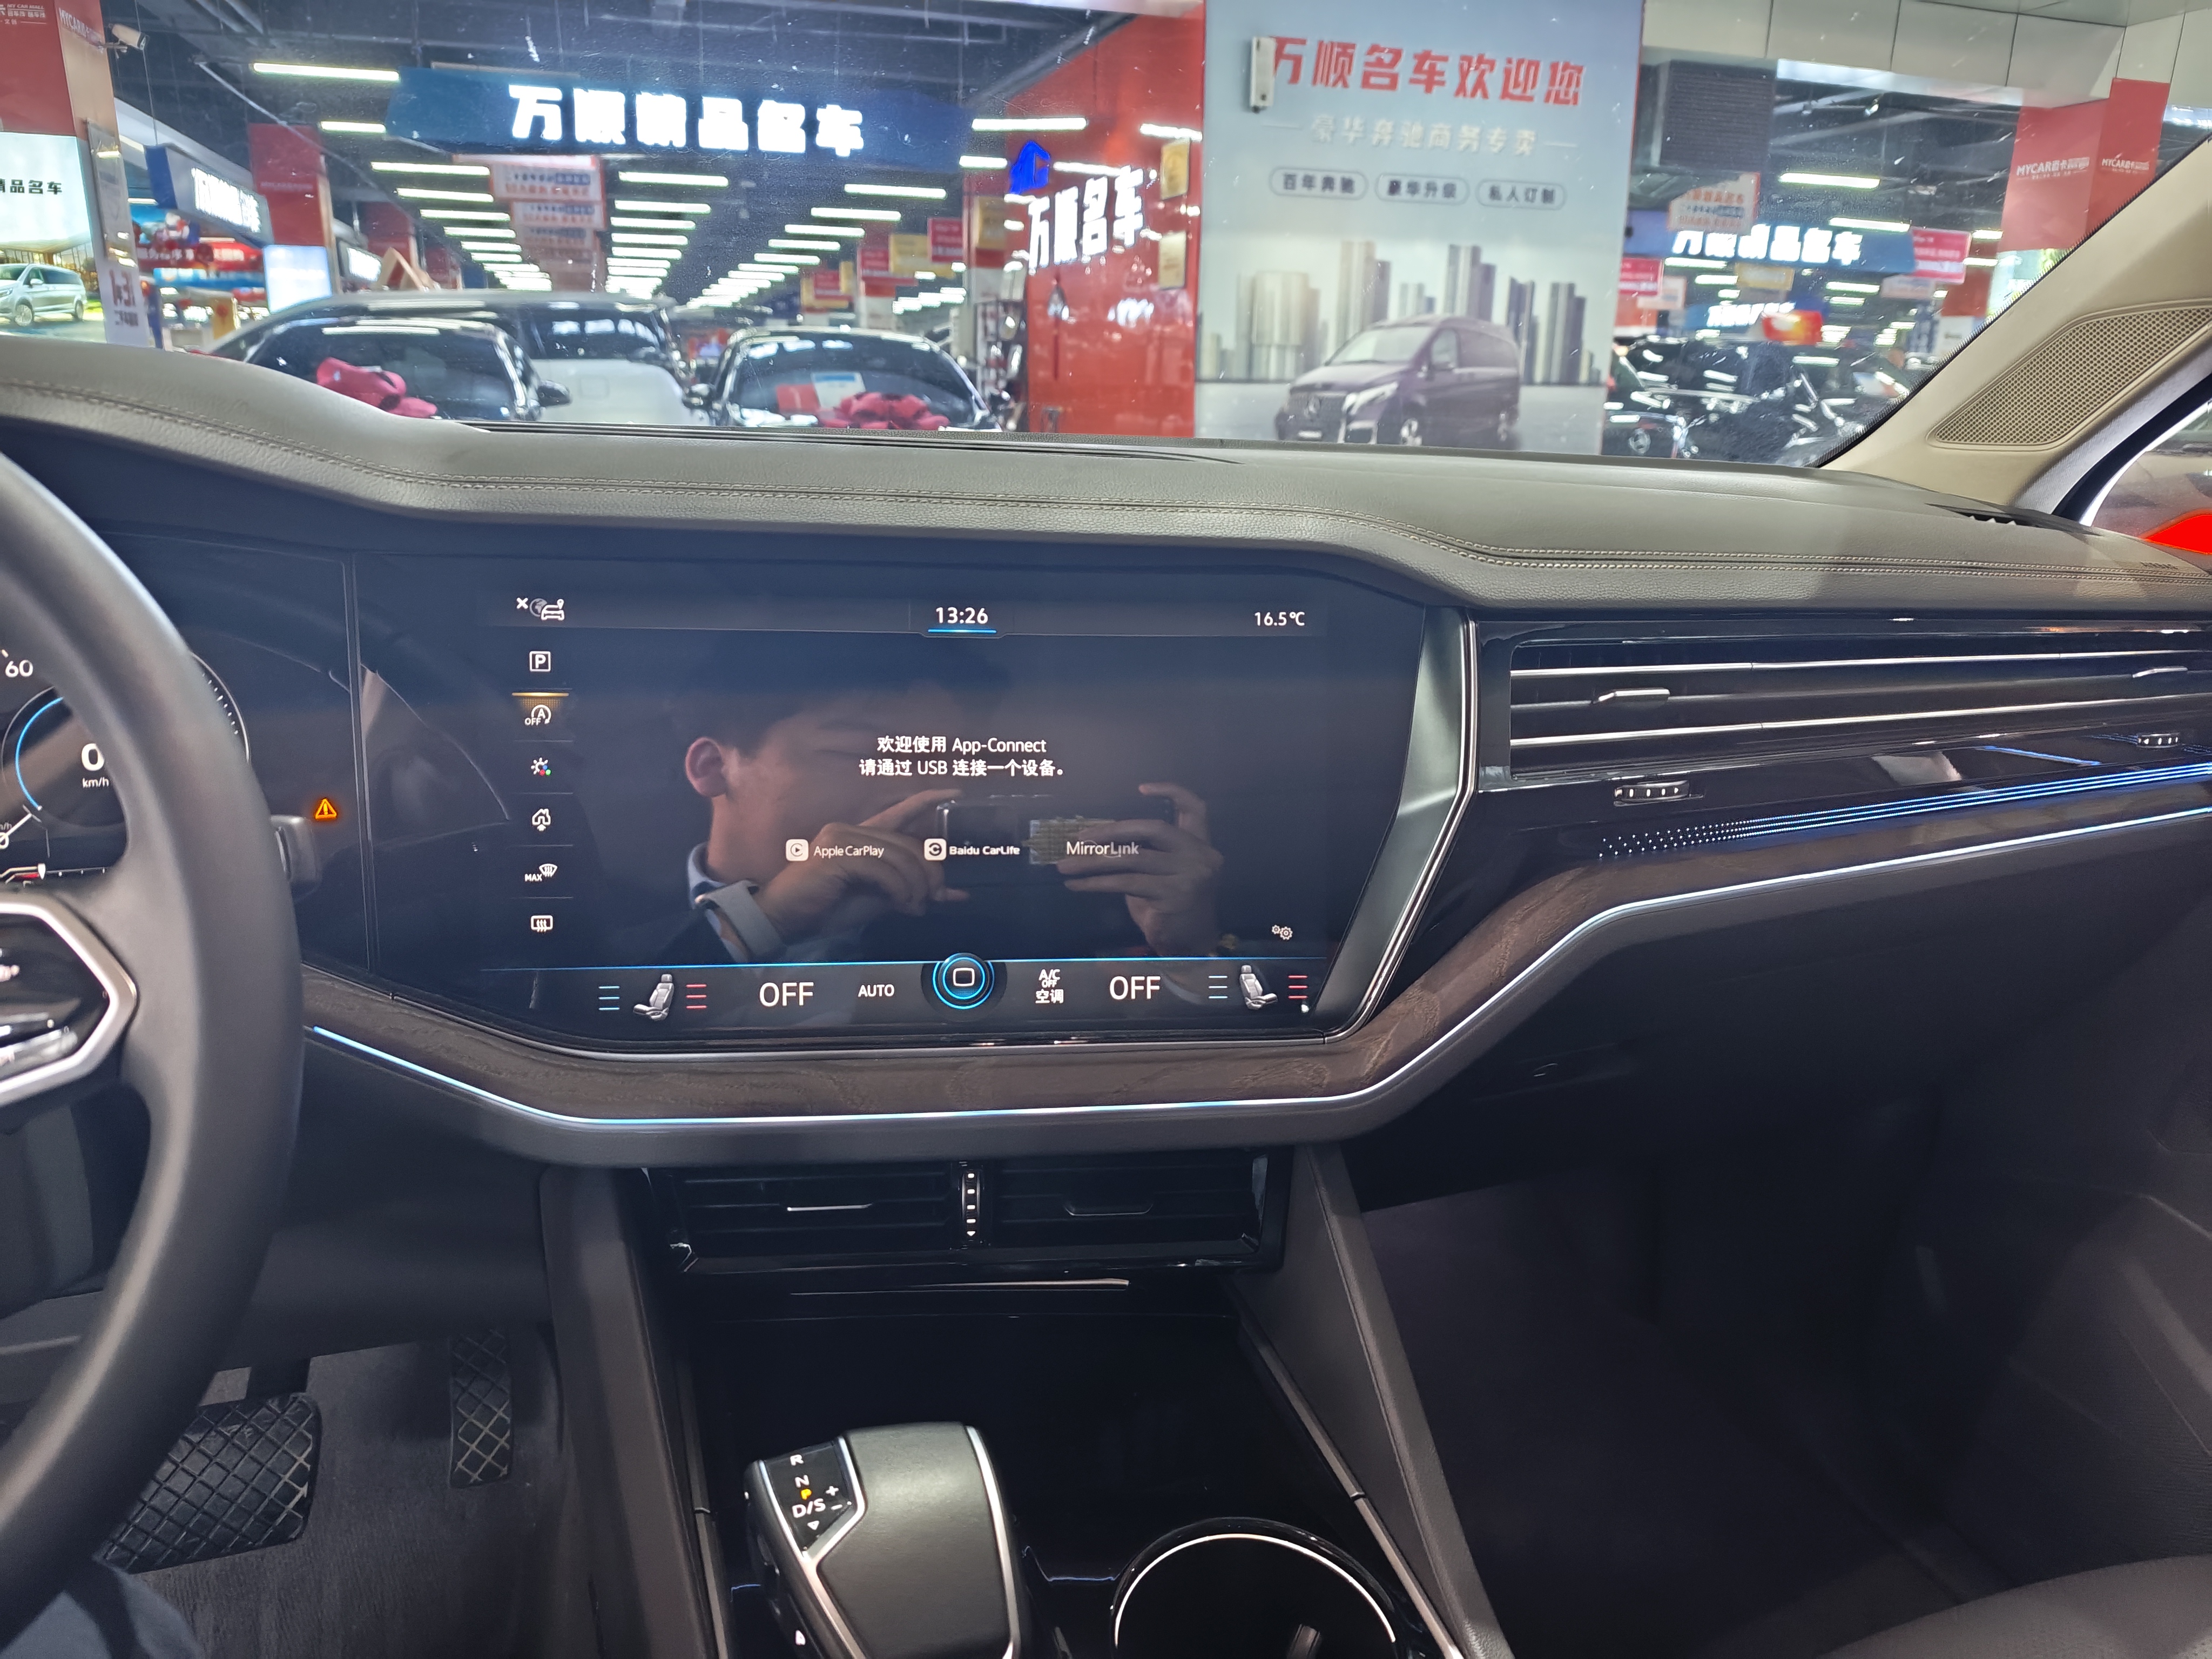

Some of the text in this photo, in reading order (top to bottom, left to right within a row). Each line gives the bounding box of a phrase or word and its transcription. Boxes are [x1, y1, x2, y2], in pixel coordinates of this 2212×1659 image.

[1271, 36, 1585, 105] 万顺名车欢迎您
[1283, 173, 1355, 194] 百年奔驰
[936, 606, 988, 624] 13:26
[5, 659, 33, 678] 60
[524, 717, 541, 726] OFF
[876, 735, 1047, 756] 欢迎使用 App-Connect
[82, 743, 105, 771] 0
[859, 758, 1063, 777] 请通过 USB 连接一个设备。
[83, 777, 109, 788] km/h
[813, 845, 885, 859] Apple CarPlay
[949, 846, 1020, 855] Baidu CarLife
[1066, 841, 1139, 857] MirrorLink
[524, 874, 542, 882] MAX
[1038, 969, 1061, 980] A/C
[858, 984, 895, 997] AUTO
[1042, 979, 1057, 988] OFF
[1109, 976, 1161, 1000] OFF
[759, 982, 814, 1007] OFF
[1035, 989, 1064, 1003] 空调
[790, 1454, 804, 1466] R
[794, 1474, 810, 1488] N
[792, 1498, 826, 1518] D/S
